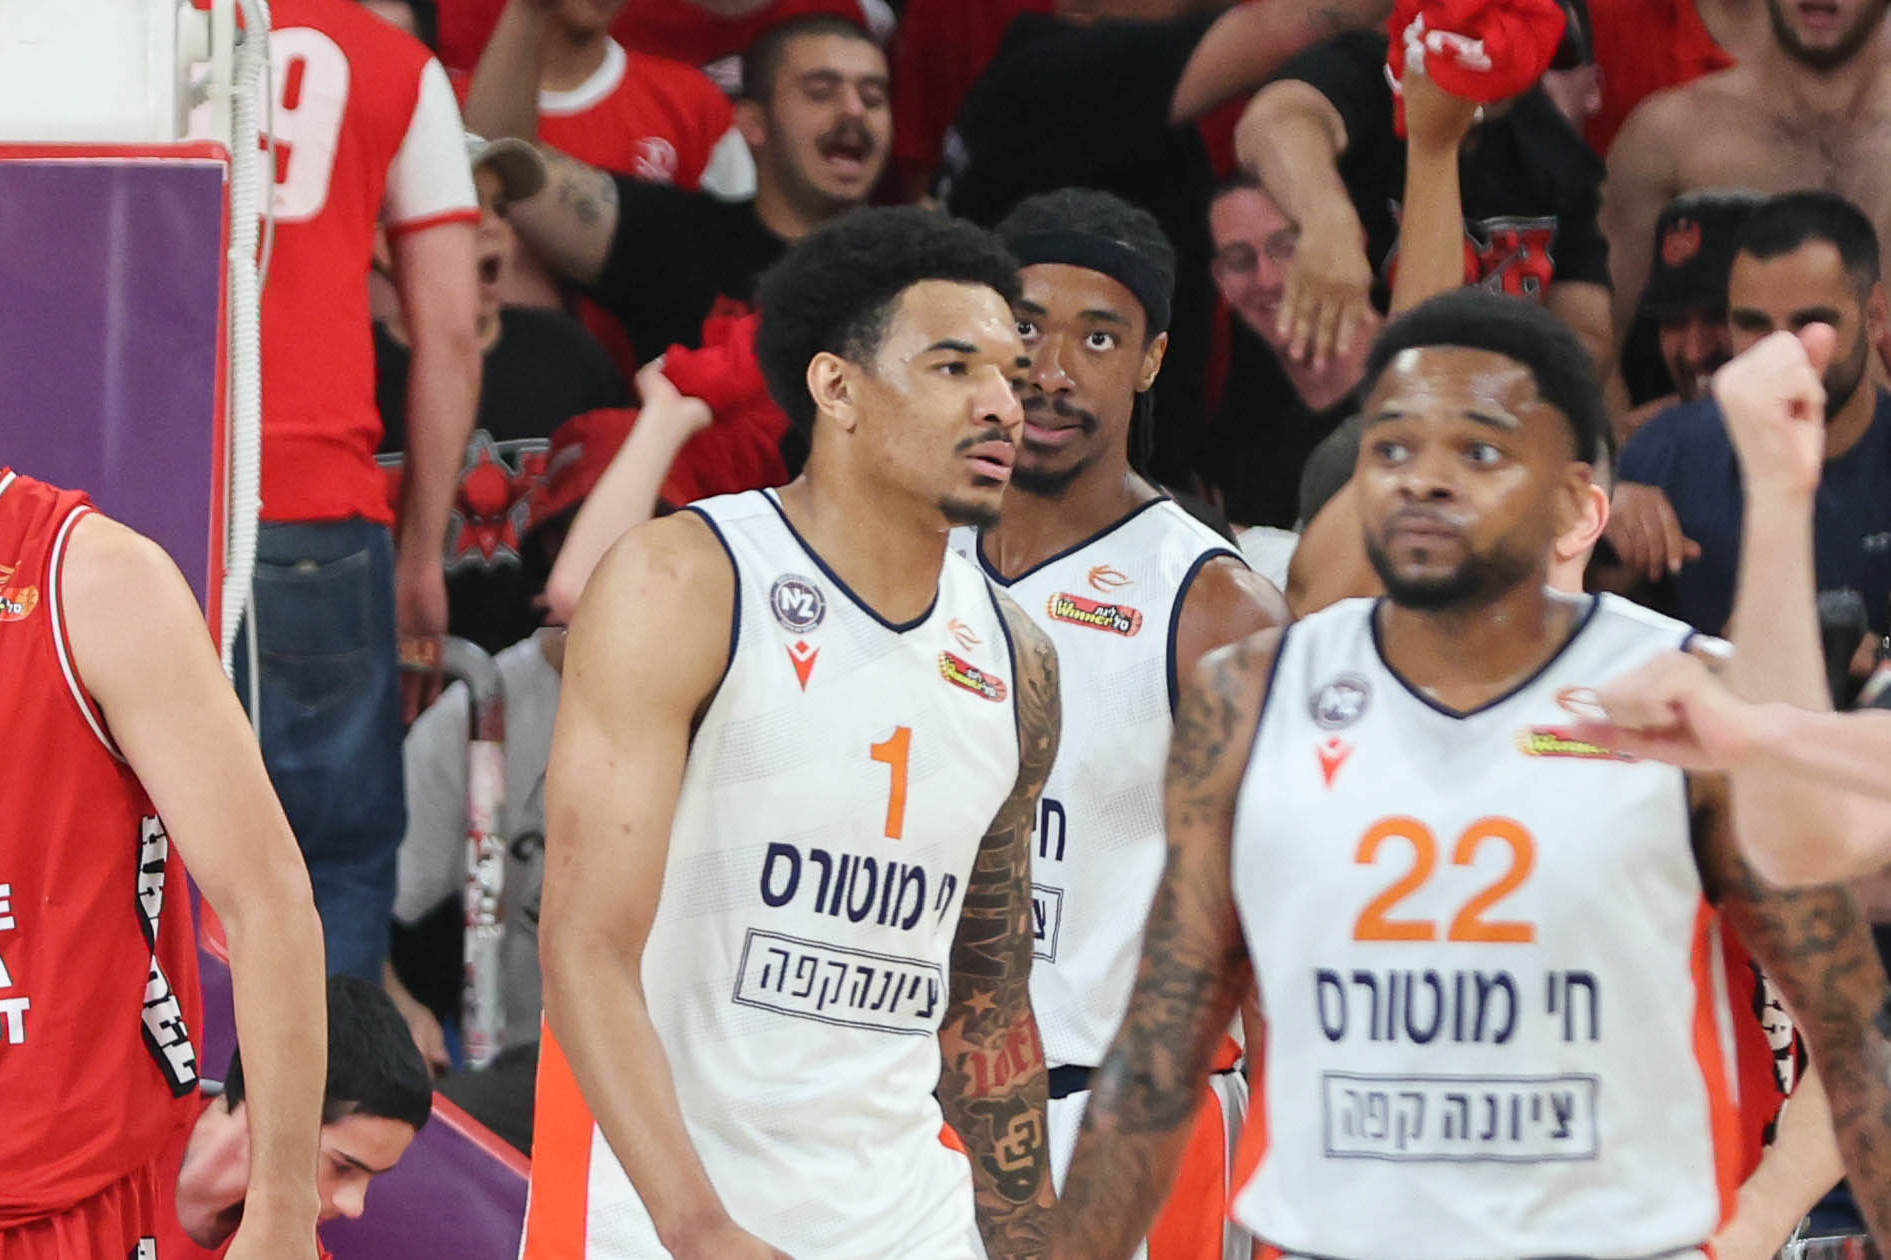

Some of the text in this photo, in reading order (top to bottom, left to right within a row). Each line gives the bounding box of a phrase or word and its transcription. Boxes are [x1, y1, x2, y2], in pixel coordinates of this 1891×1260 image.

[870, 726, 912, 840] 1
[760, 842, 927, 932] מוטורס
[1352, 814, 1537, 943] 22
[1314, 967, 1601, 1045] חי מוטורס
[1341, 1089, 1575, 1150] ציונה קפה
